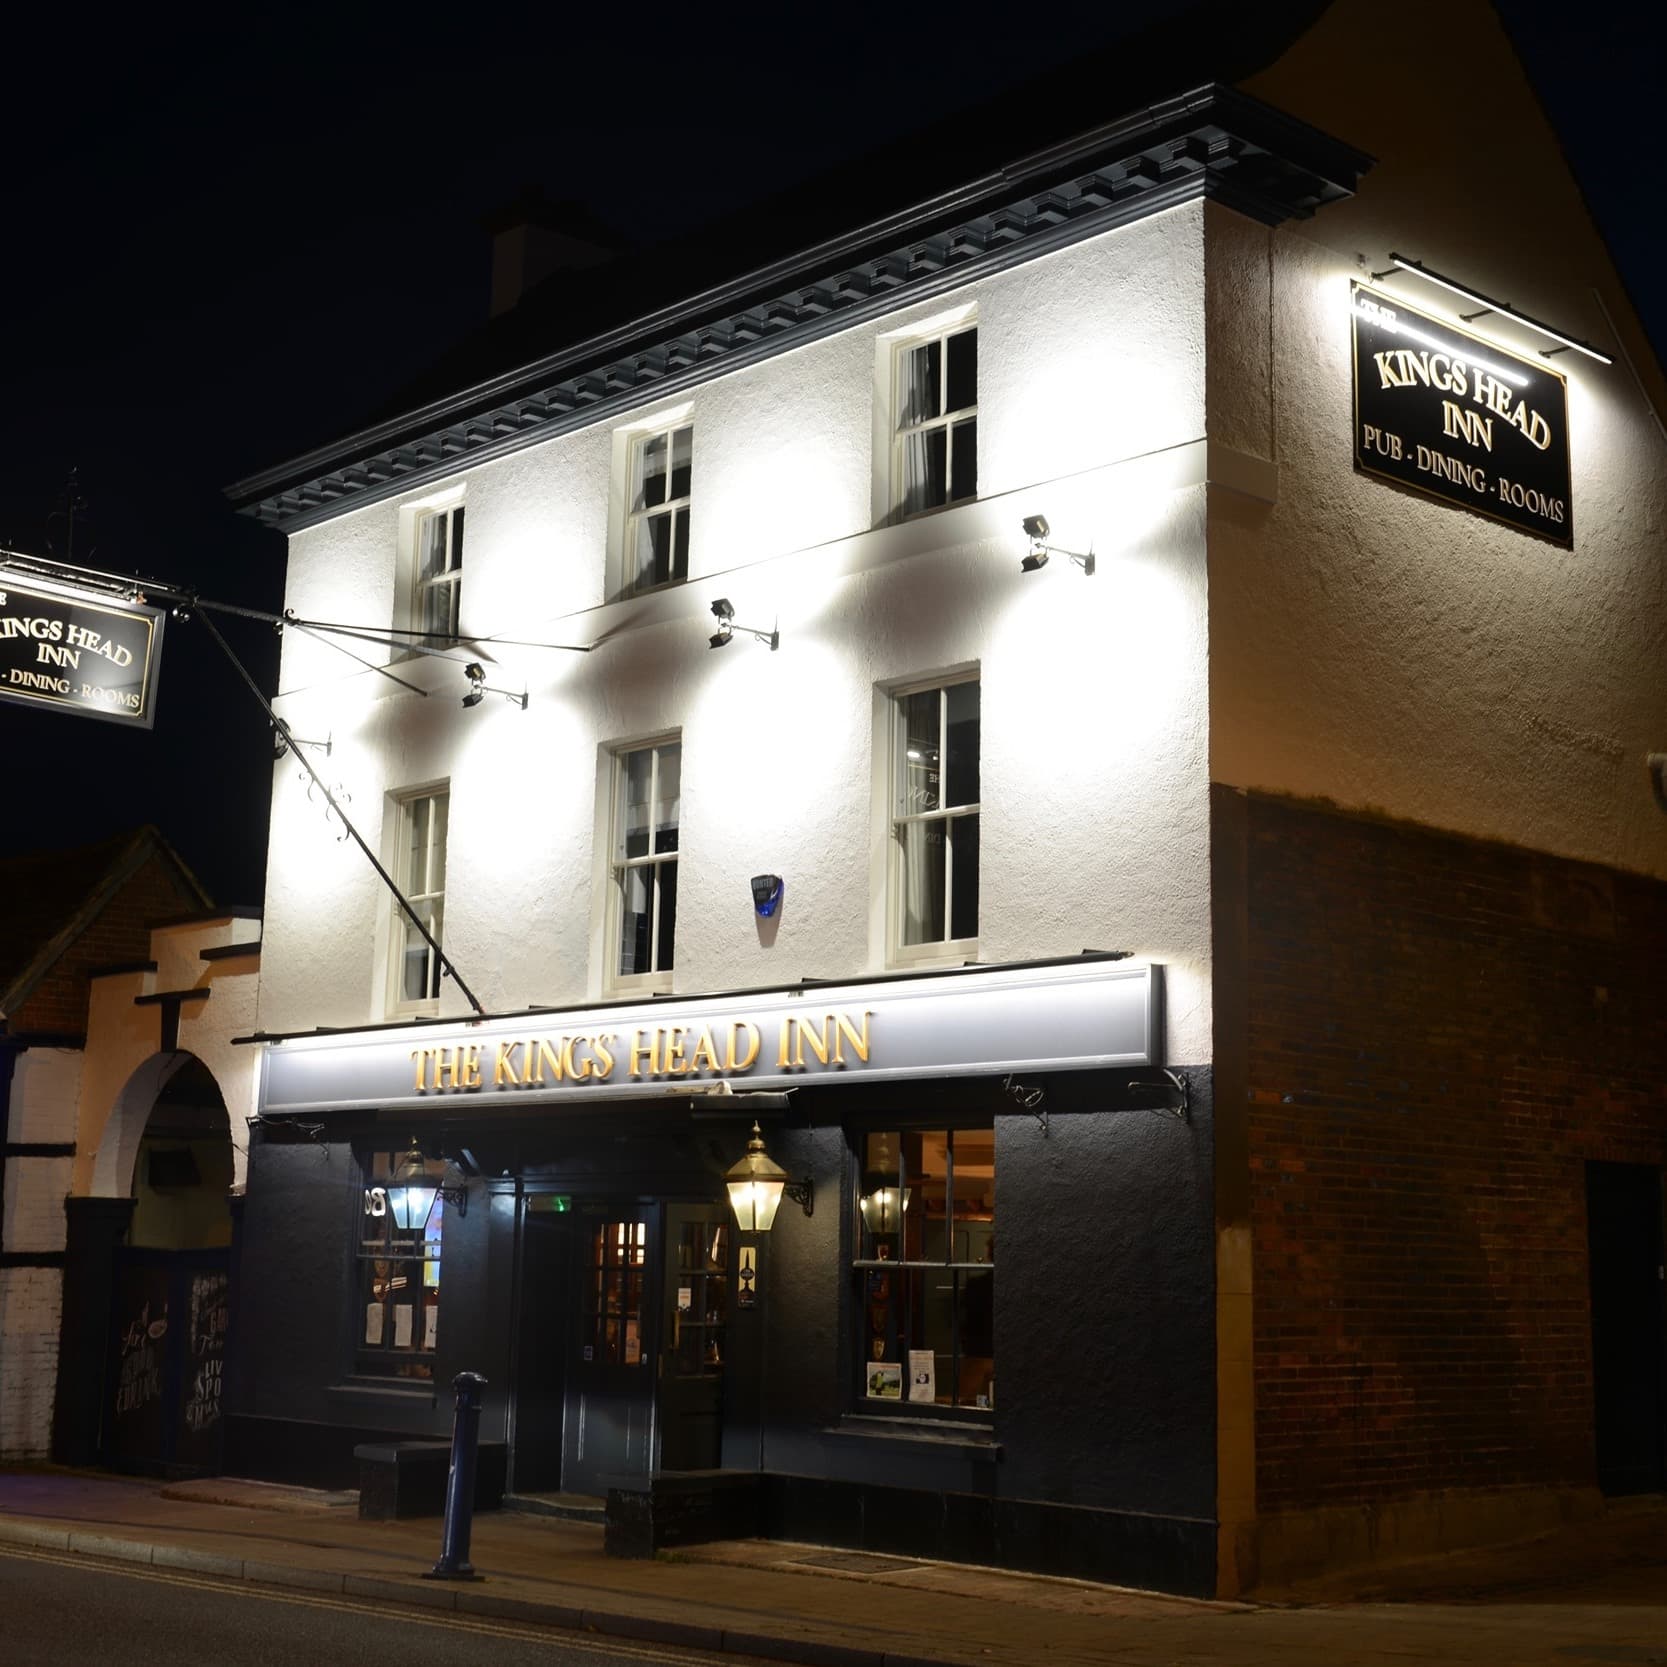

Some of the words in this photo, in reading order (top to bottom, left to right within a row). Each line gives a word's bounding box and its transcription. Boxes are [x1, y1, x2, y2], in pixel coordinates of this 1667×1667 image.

[1374, 350, 1468, 396] KINGS
[1473, 368, 1551, 450] HEAD
[1442, 400, 1493, 452] INN
[1364, 424, 1403, 461] PUB
[1417, 445, 1486, 493] DINING
[1499, 477, 1564, 523] ROOMS
[0, 617, 63, 641] INGS
[66, 624, 133, 667] HEAD
[36, 642, 81, 670] INN
[10, 669, 70, 694] DINING
[82, 683, 140, 708] ROOMS
[411, 1045, 484, 1091] THE
[493, 1034, 617, 1084] KINGS
[627, 1022, 761, 1076] HEAD
[776, 1011, 873, 1066] INN
